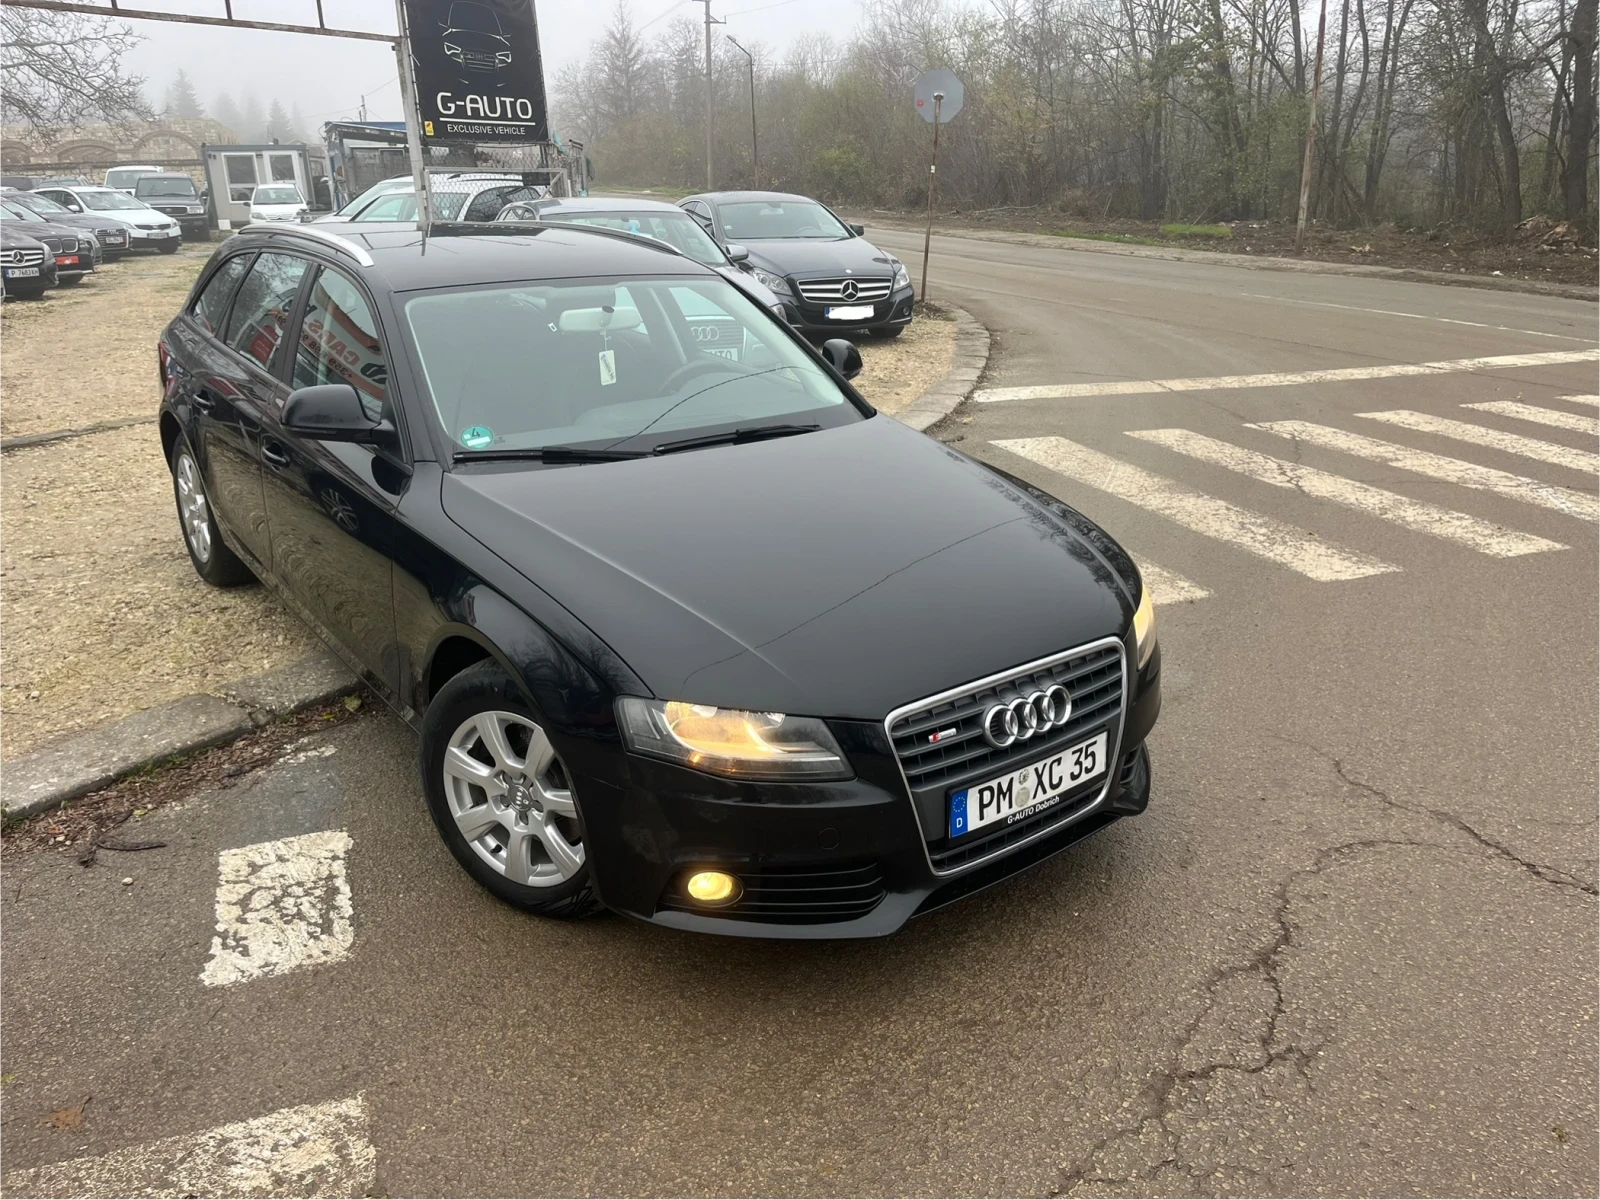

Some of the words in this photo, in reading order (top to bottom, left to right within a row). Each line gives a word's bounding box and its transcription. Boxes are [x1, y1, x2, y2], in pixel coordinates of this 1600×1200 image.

[437, 92, 532, 119] G-AUTO
[447, 124, 492, 134] EXCLUSIVE
[493, 126, 526, 135] VEHICLE
[472, 428, 480, 437] 4
[978, 777, 1013, 821] PM
[1032, 757, 1062, 799] XC
[1070, 740, 1098, 781] 35
[1007, 808, 1034, 824] G-AUTO
[1035, 796, 1060, 812] Dobrich
[956, 817, 963, 828] D
